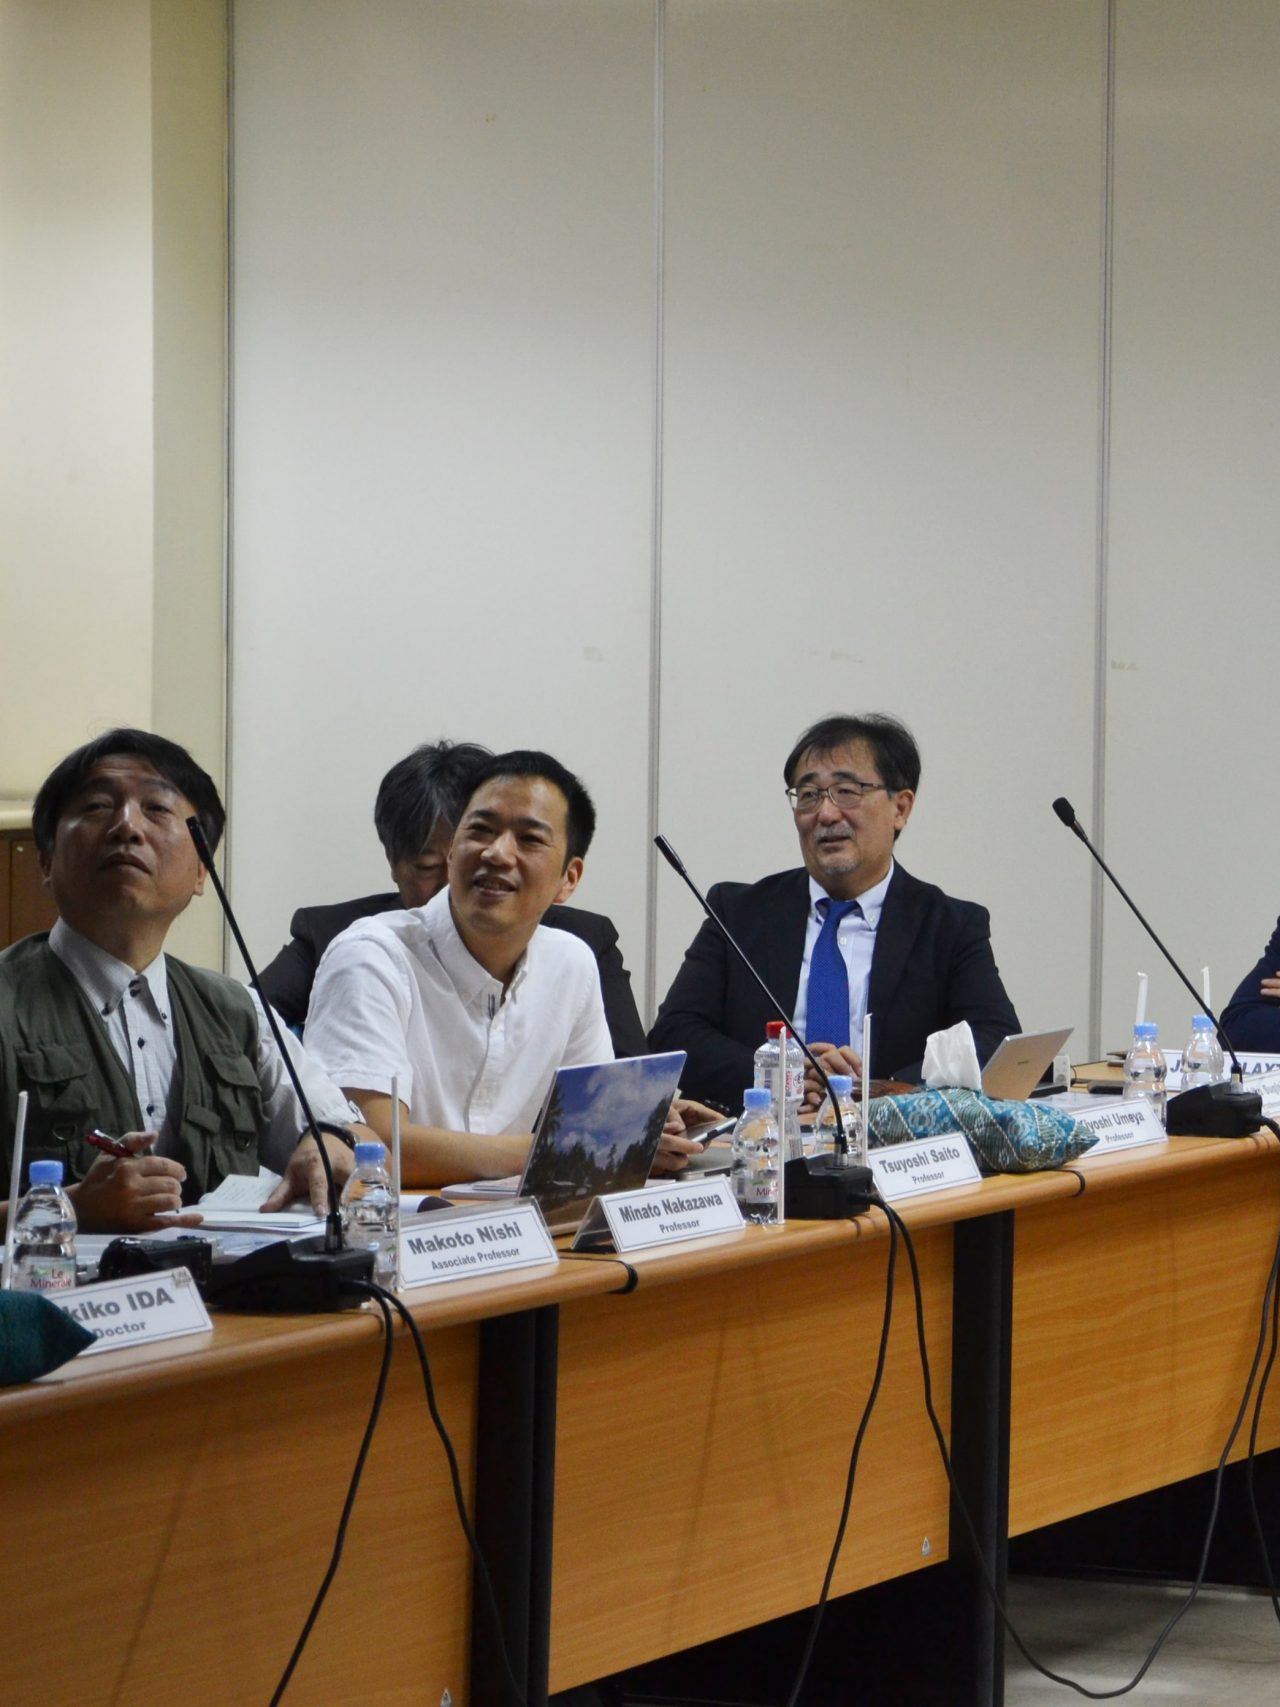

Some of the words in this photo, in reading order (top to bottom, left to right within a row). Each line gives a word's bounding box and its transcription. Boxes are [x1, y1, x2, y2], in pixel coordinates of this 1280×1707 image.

[1112, 1110, 1145, 1126] Umeya
[1105, 1132, 1135, 1144] Professor
[879, 1151, 930, 1174] Tsuyoshi
[930, 1146, 961, 1164] Saito
[912, 1171, 945, 1185] Professor
[618, 1202, 662, 1224] Minato
[661, 1193, 723, 1215] Nakazawa
[659, 1218, 700, 1234] Professor
[406, 1231, 475, 1256] Makoto
[476, 1221, 523, 1243] Nishi
[431, 1254, 477, 1271] Associate
[477, 1246, 520, 1264] Professor
[62, 1300, 121, 1322] kiko
[126, 1287, 176, 1312] IDA
[92, 1320, 147, 1339] Doctor
